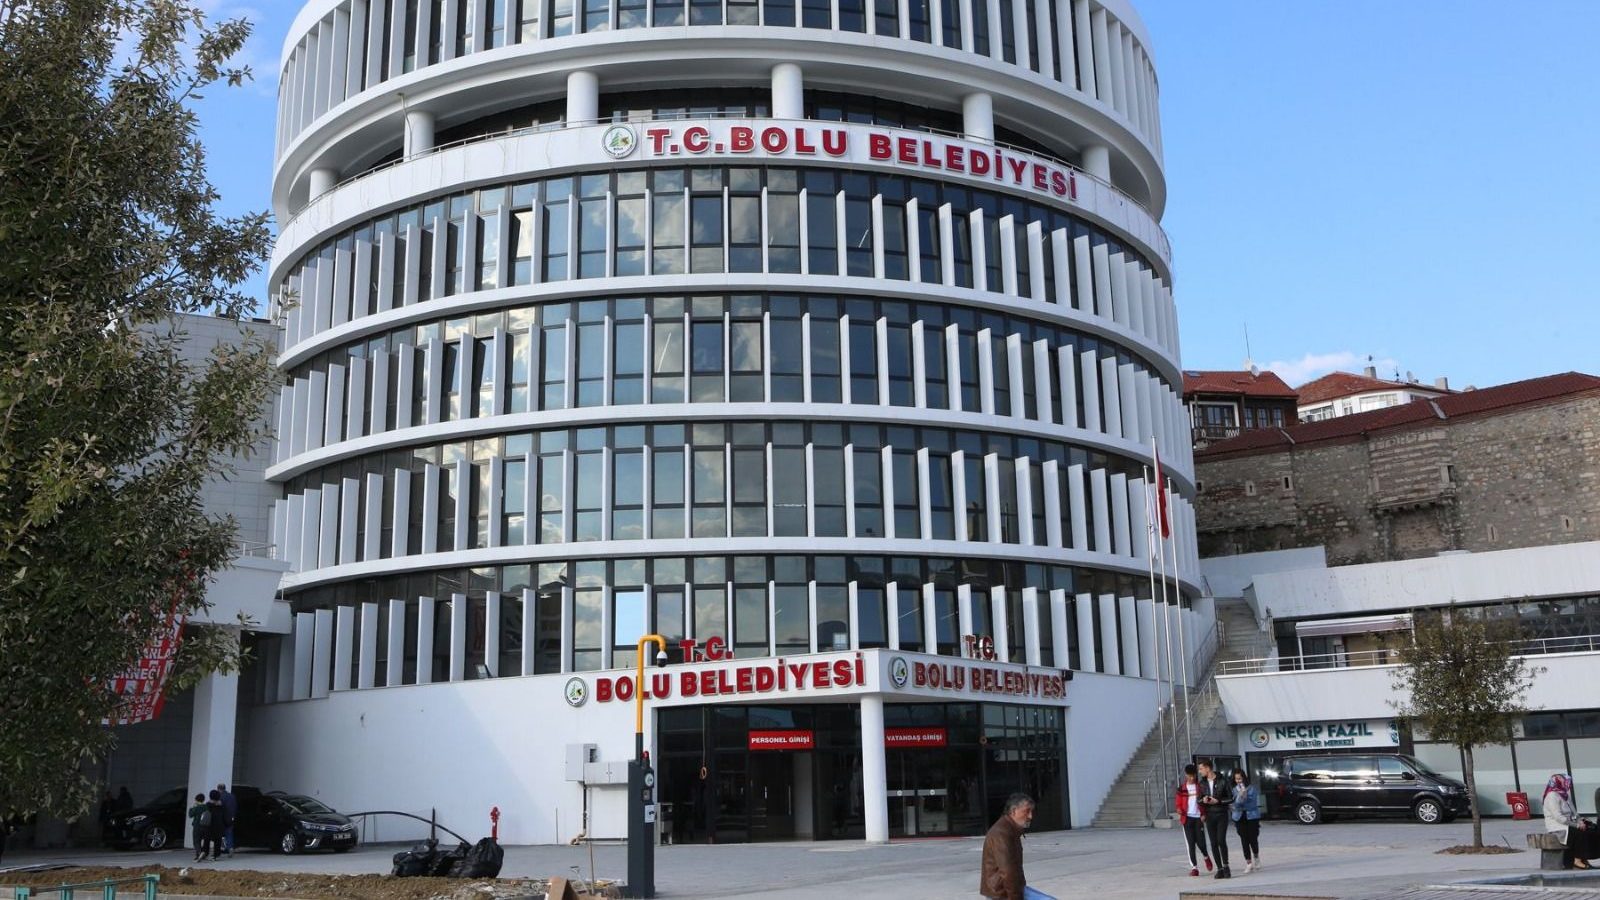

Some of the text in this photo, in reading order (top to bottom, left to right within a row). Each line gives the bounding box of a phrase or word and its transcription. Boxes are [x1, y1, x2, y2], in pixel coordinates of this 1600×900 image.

[869, 132, 1078, 200] BELEDİYESİ
[679, 635, 735, 663] T.C.
[963, 634, 998, 661] T.C.
[680, 652, 867, 697] BELEDİYESİ
[913, 661, 965, 692] BOLU
[1275, 722, 1373, 740] NECİP FAZIL
